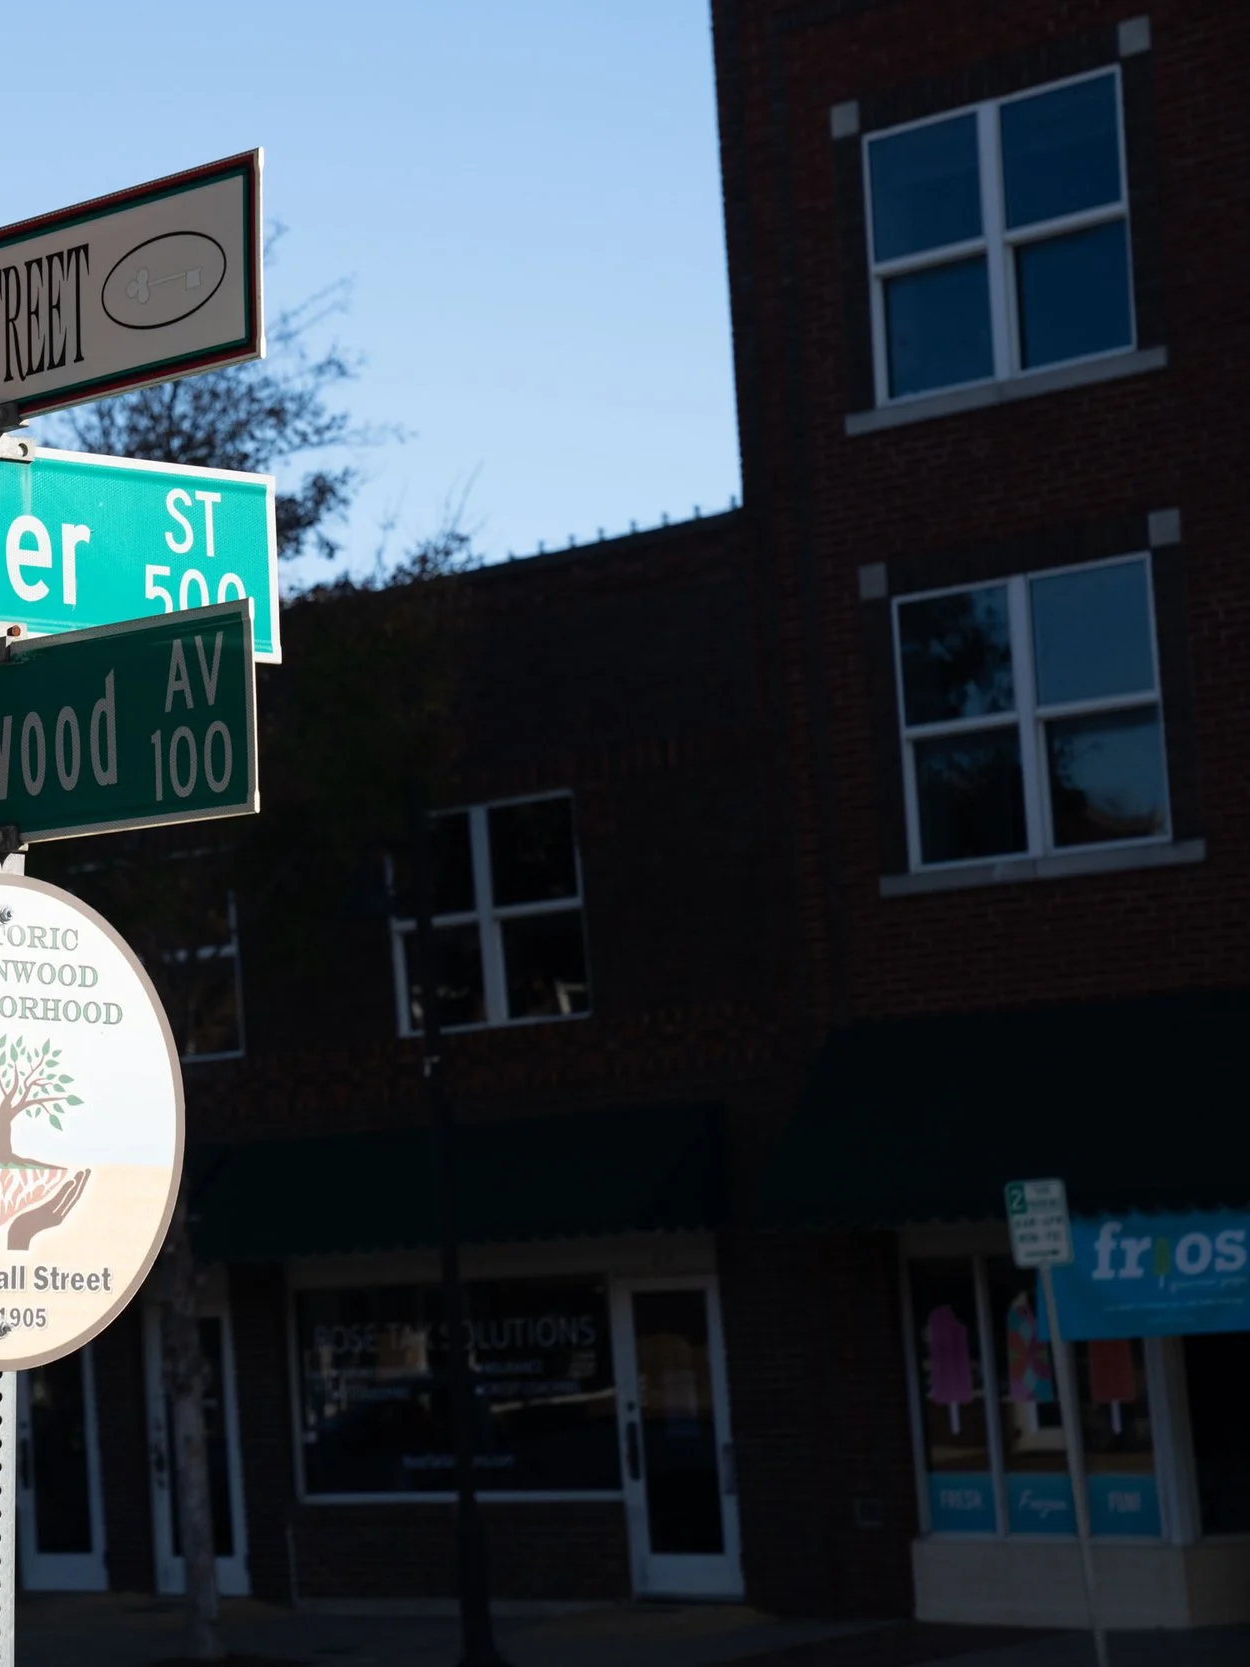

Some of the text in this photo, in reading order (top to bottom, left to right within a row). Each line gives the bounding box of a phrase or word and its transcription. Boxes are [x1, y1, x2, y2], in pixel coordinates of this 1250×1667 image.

[164, 487, 222, 558] ST
[164, 630, 224, 714] AV
[151, 719, 233, 802] 100
[33, 1264, 111, 1292] Street
